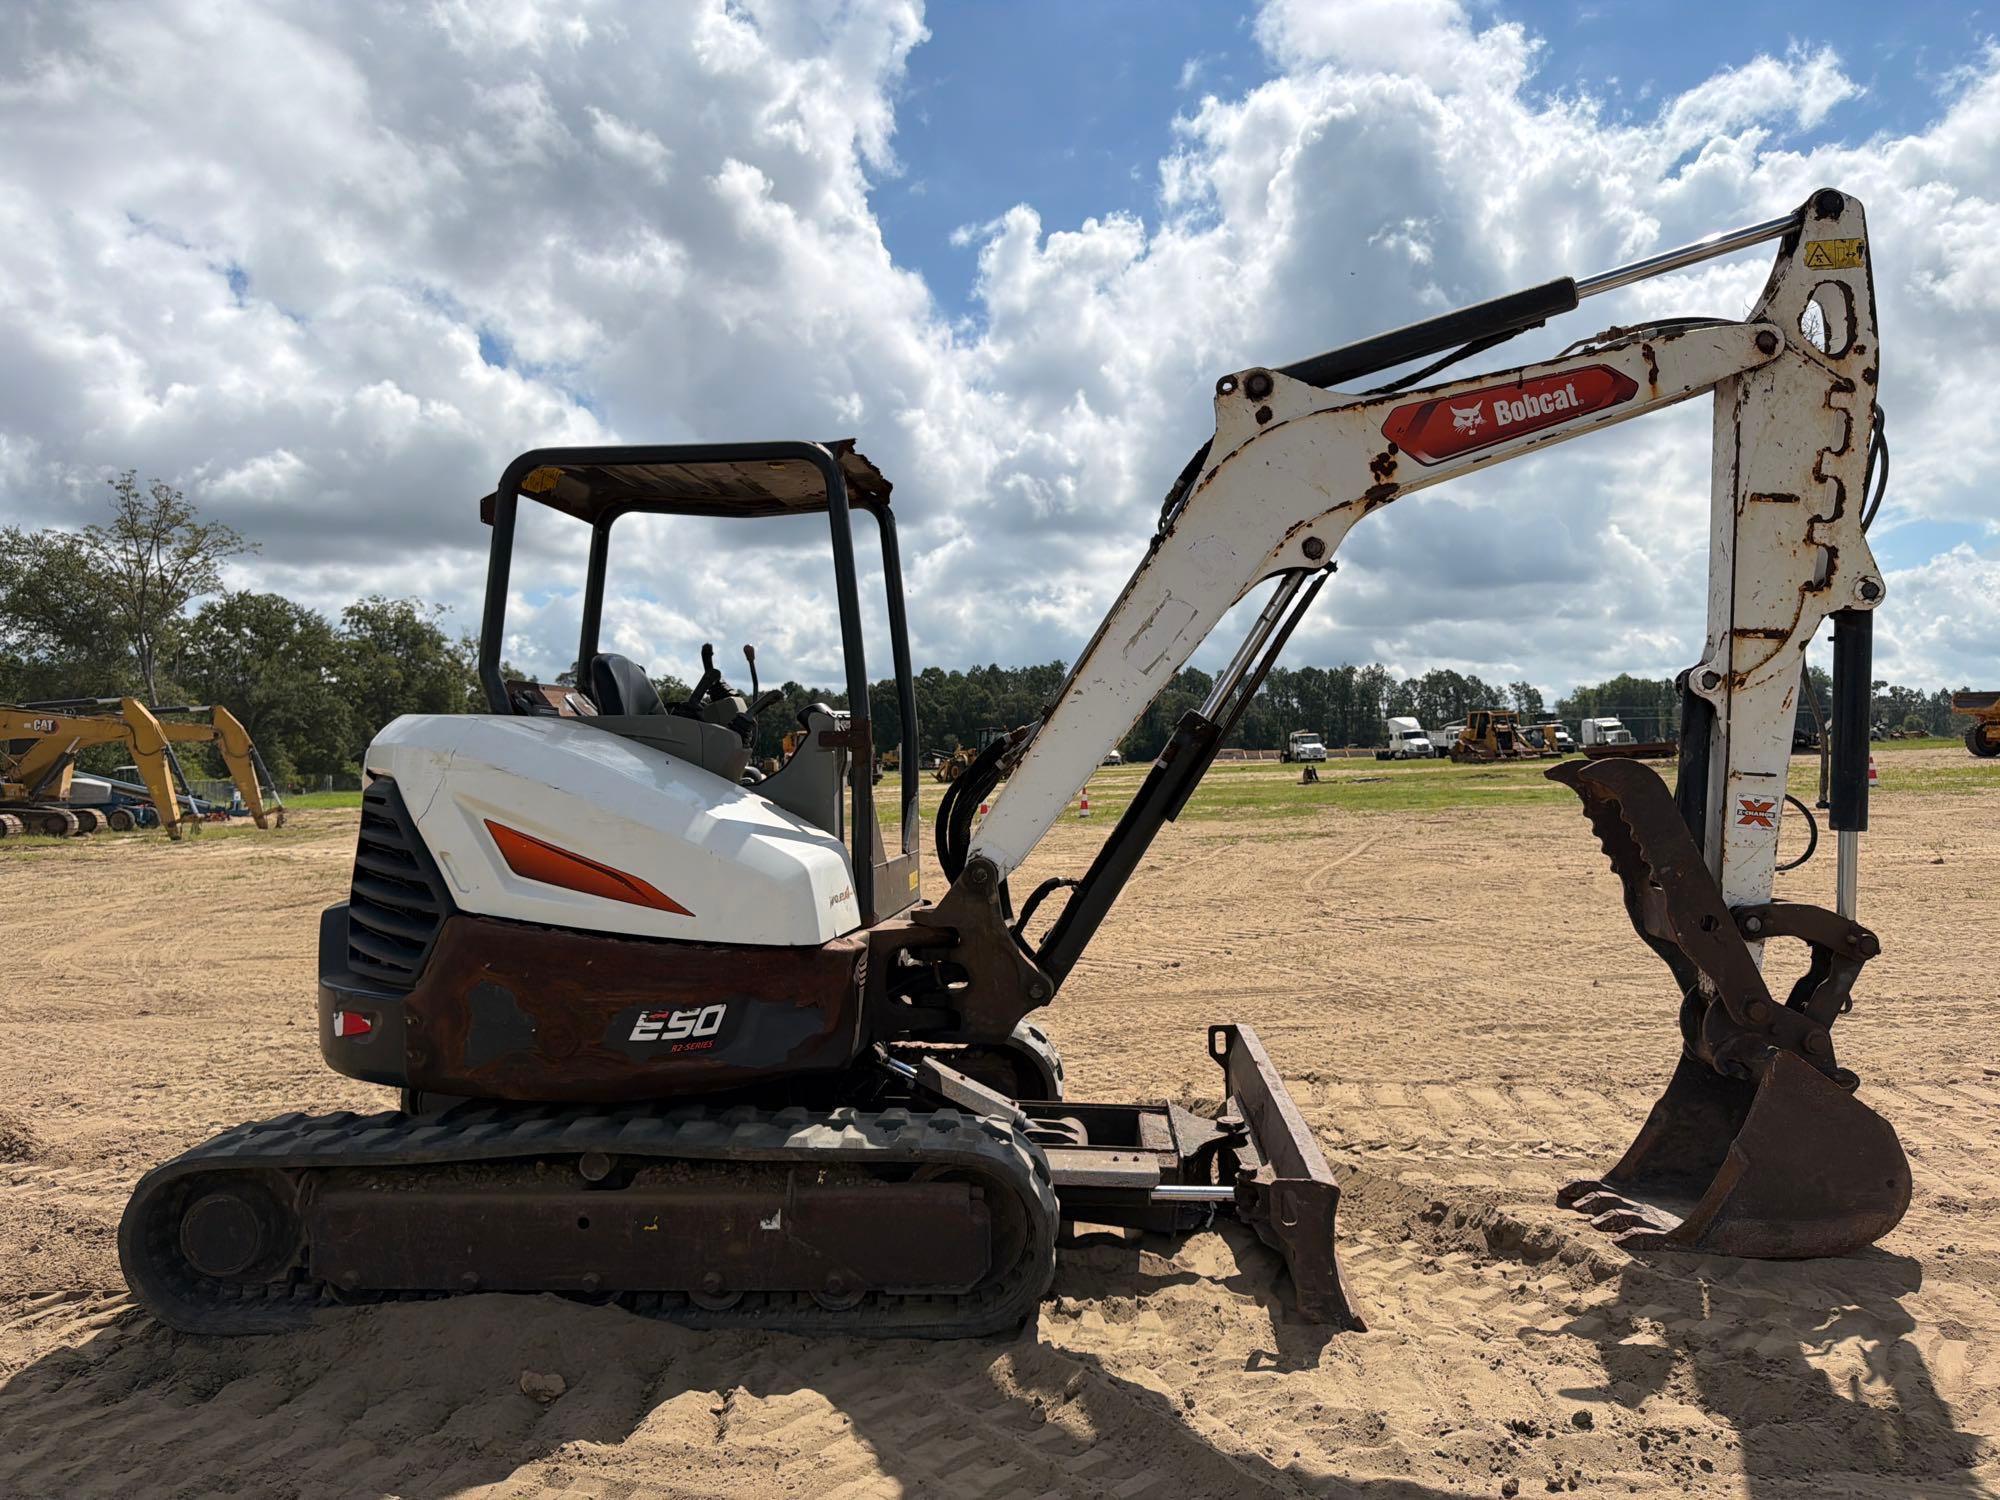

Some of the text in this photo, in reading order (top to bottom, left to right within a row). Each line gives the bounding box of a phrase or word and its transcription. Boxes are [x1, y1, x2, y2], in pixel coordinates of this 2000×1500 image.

[1493, 383, 1579, 426] Bobcat
[33, 719, 54, 731] CAT
[628, 1003, 727, 1041] E50
[671, 1040, 714, 1053] R2-SERIES
